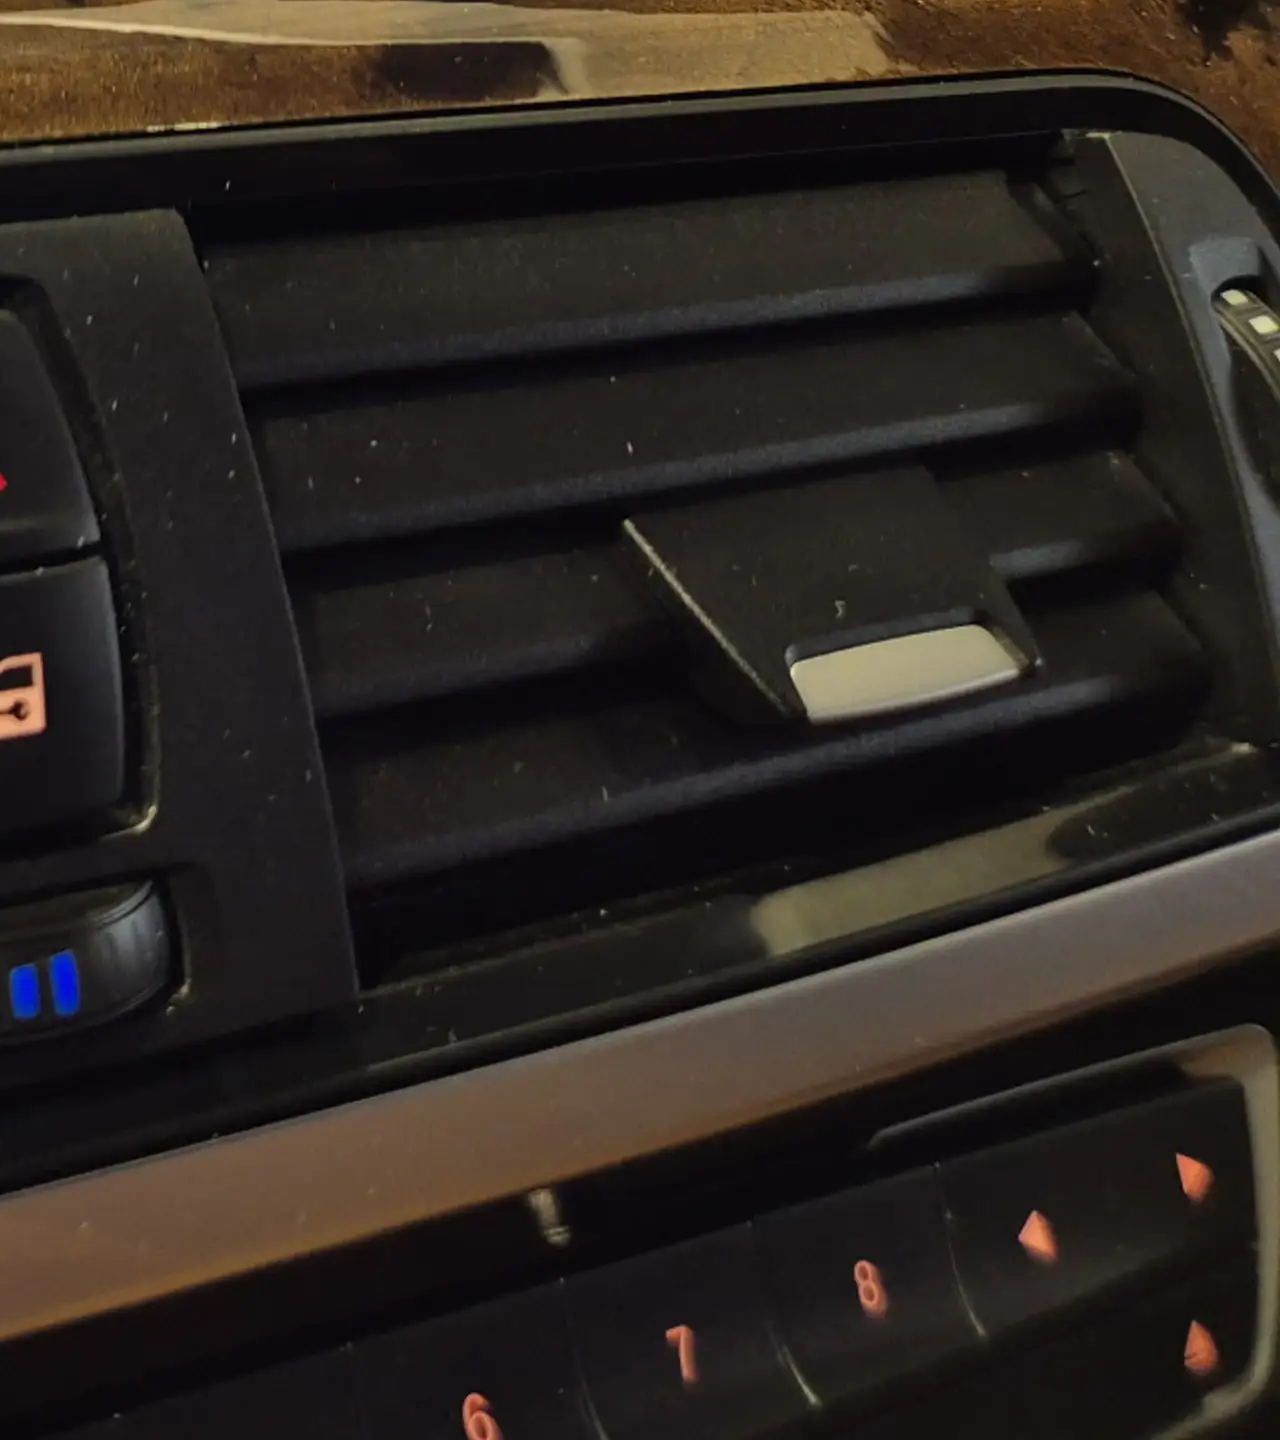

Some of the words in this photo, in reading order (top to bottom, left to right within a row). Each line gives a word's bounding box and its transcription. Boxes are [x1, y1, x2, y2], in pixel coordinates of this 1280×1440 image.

[854, 1260, 889, 1319] 8
[665, 1324, 699, 1385] 7
[462, 1392, 504, 1440] 6
